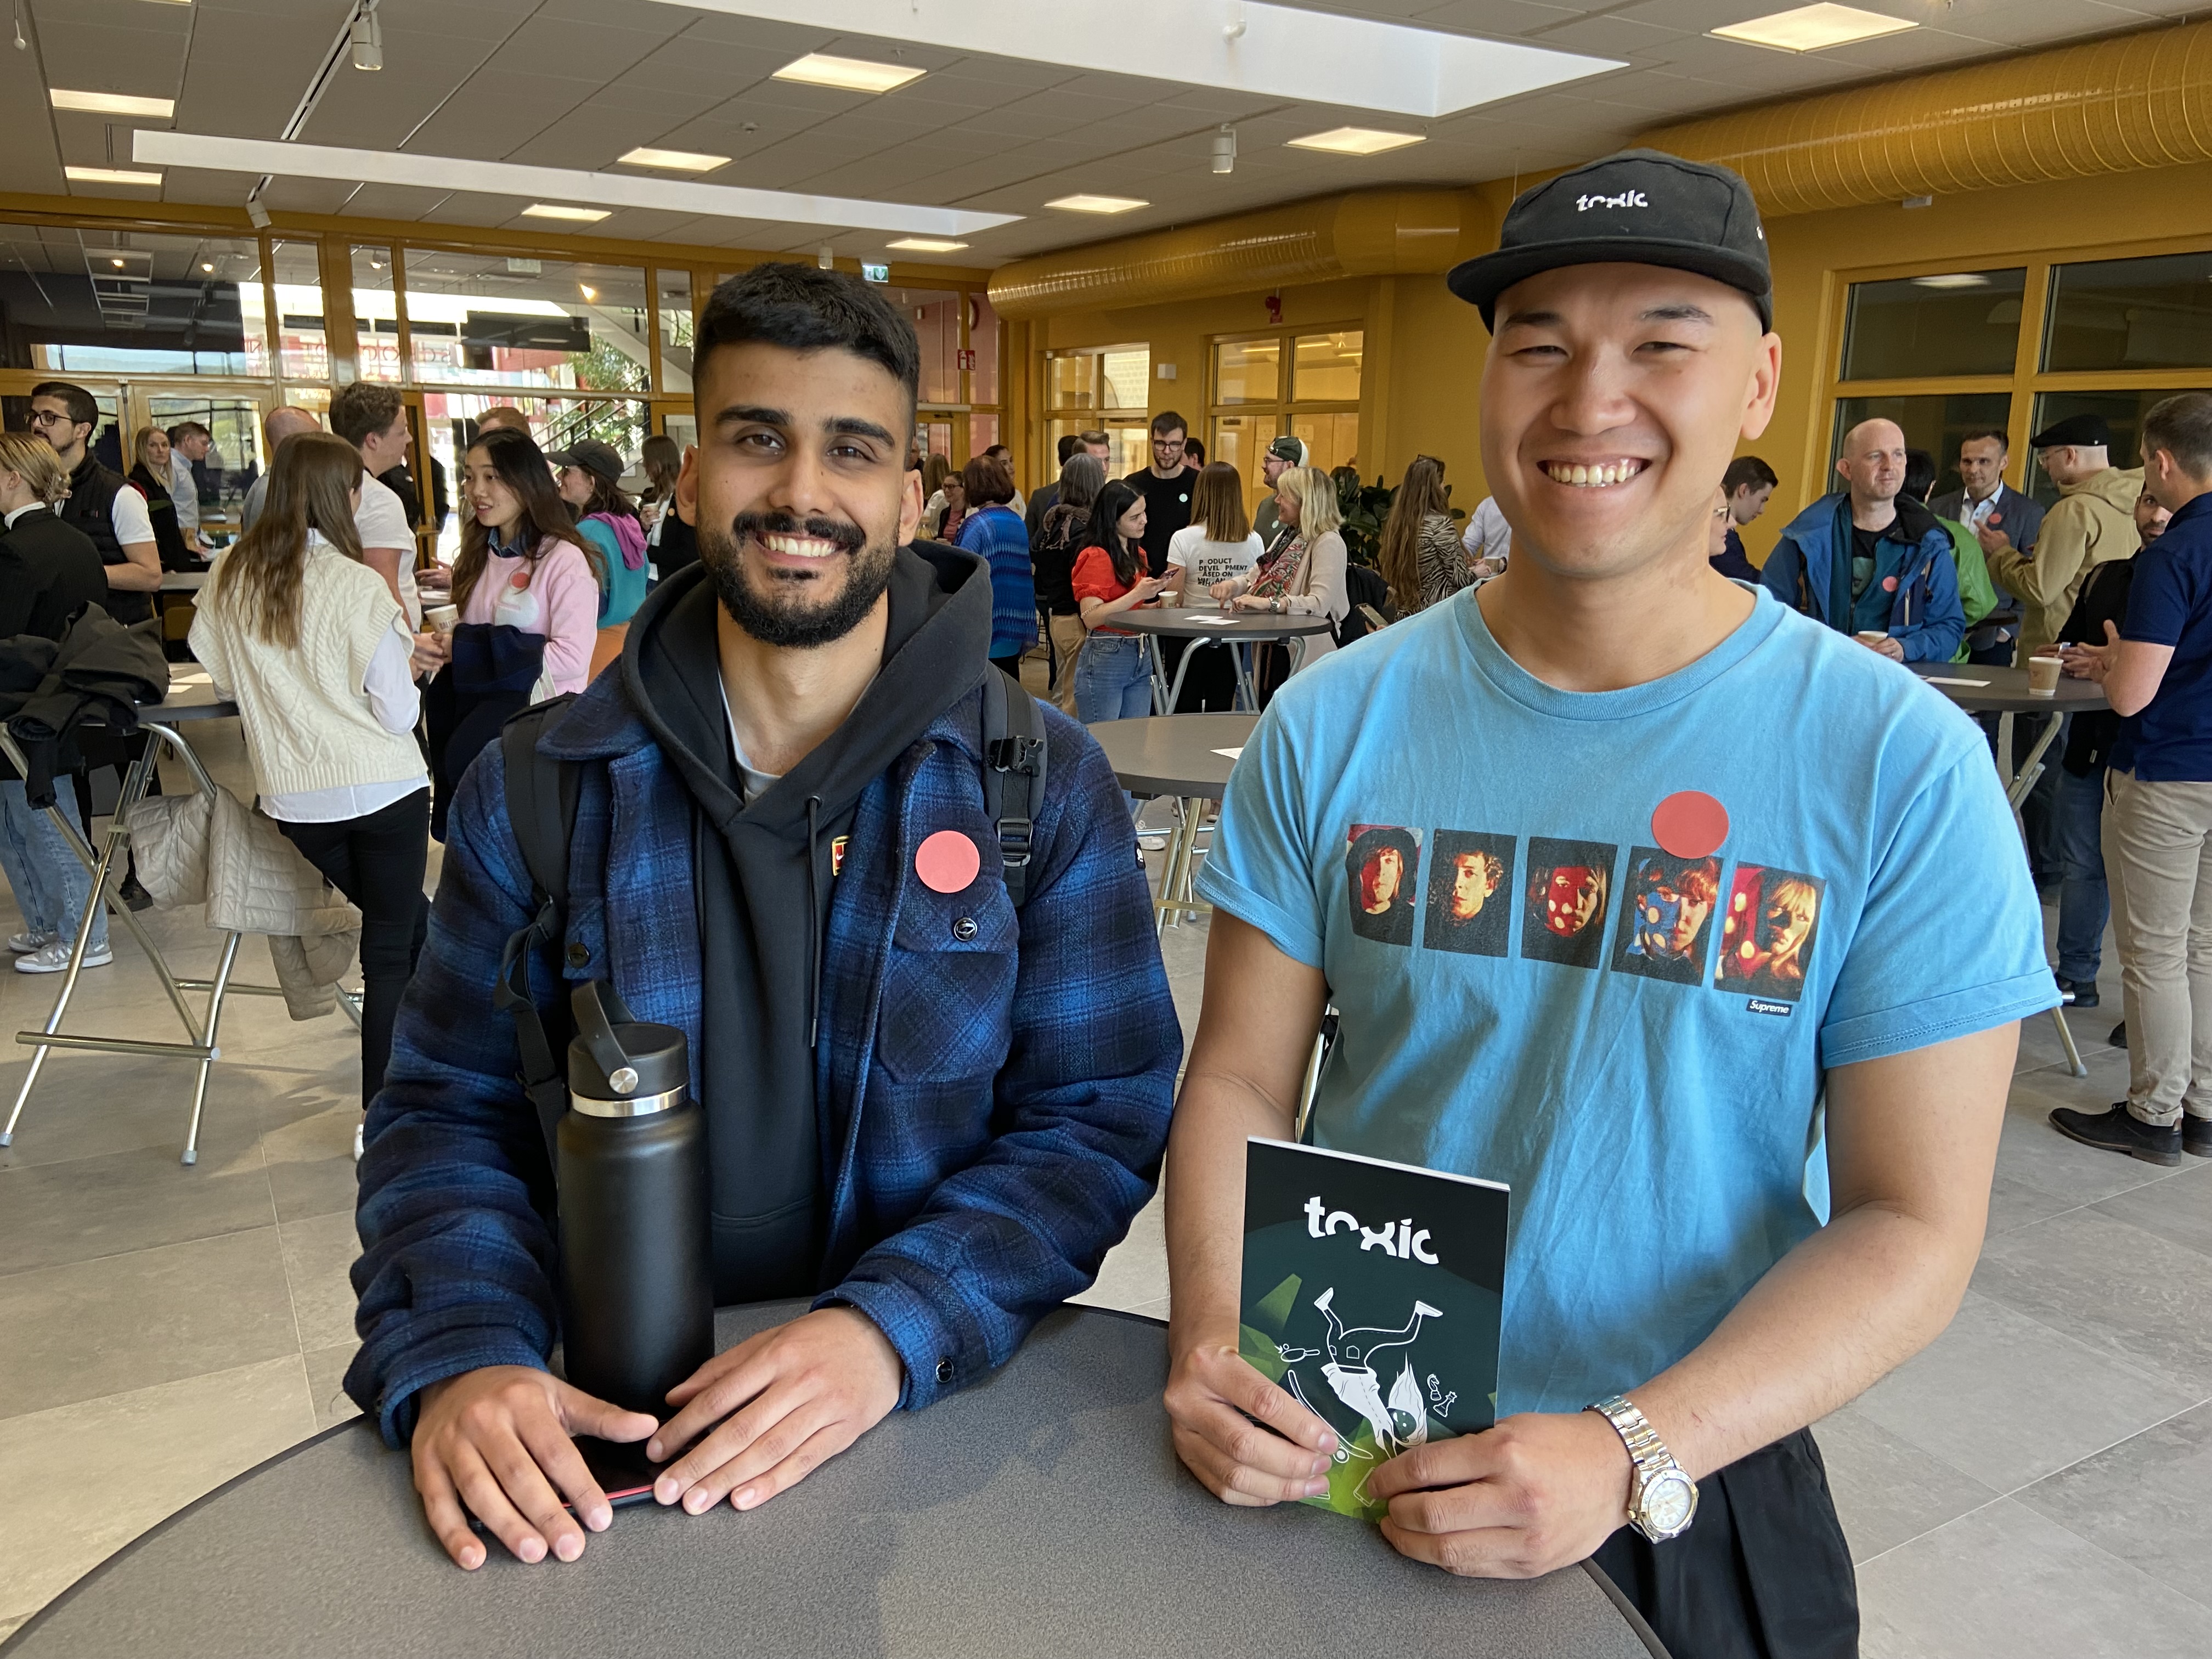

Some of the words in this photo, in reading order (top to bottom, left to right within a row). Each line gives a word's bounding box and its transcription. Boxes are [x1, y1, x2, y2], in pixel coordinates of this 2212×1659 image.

[1576, 189, 1648, 212] toxic
[1750, 1000, 1790, 1013] Supreme
[1304, 1196, 1440, 1265] toxic
